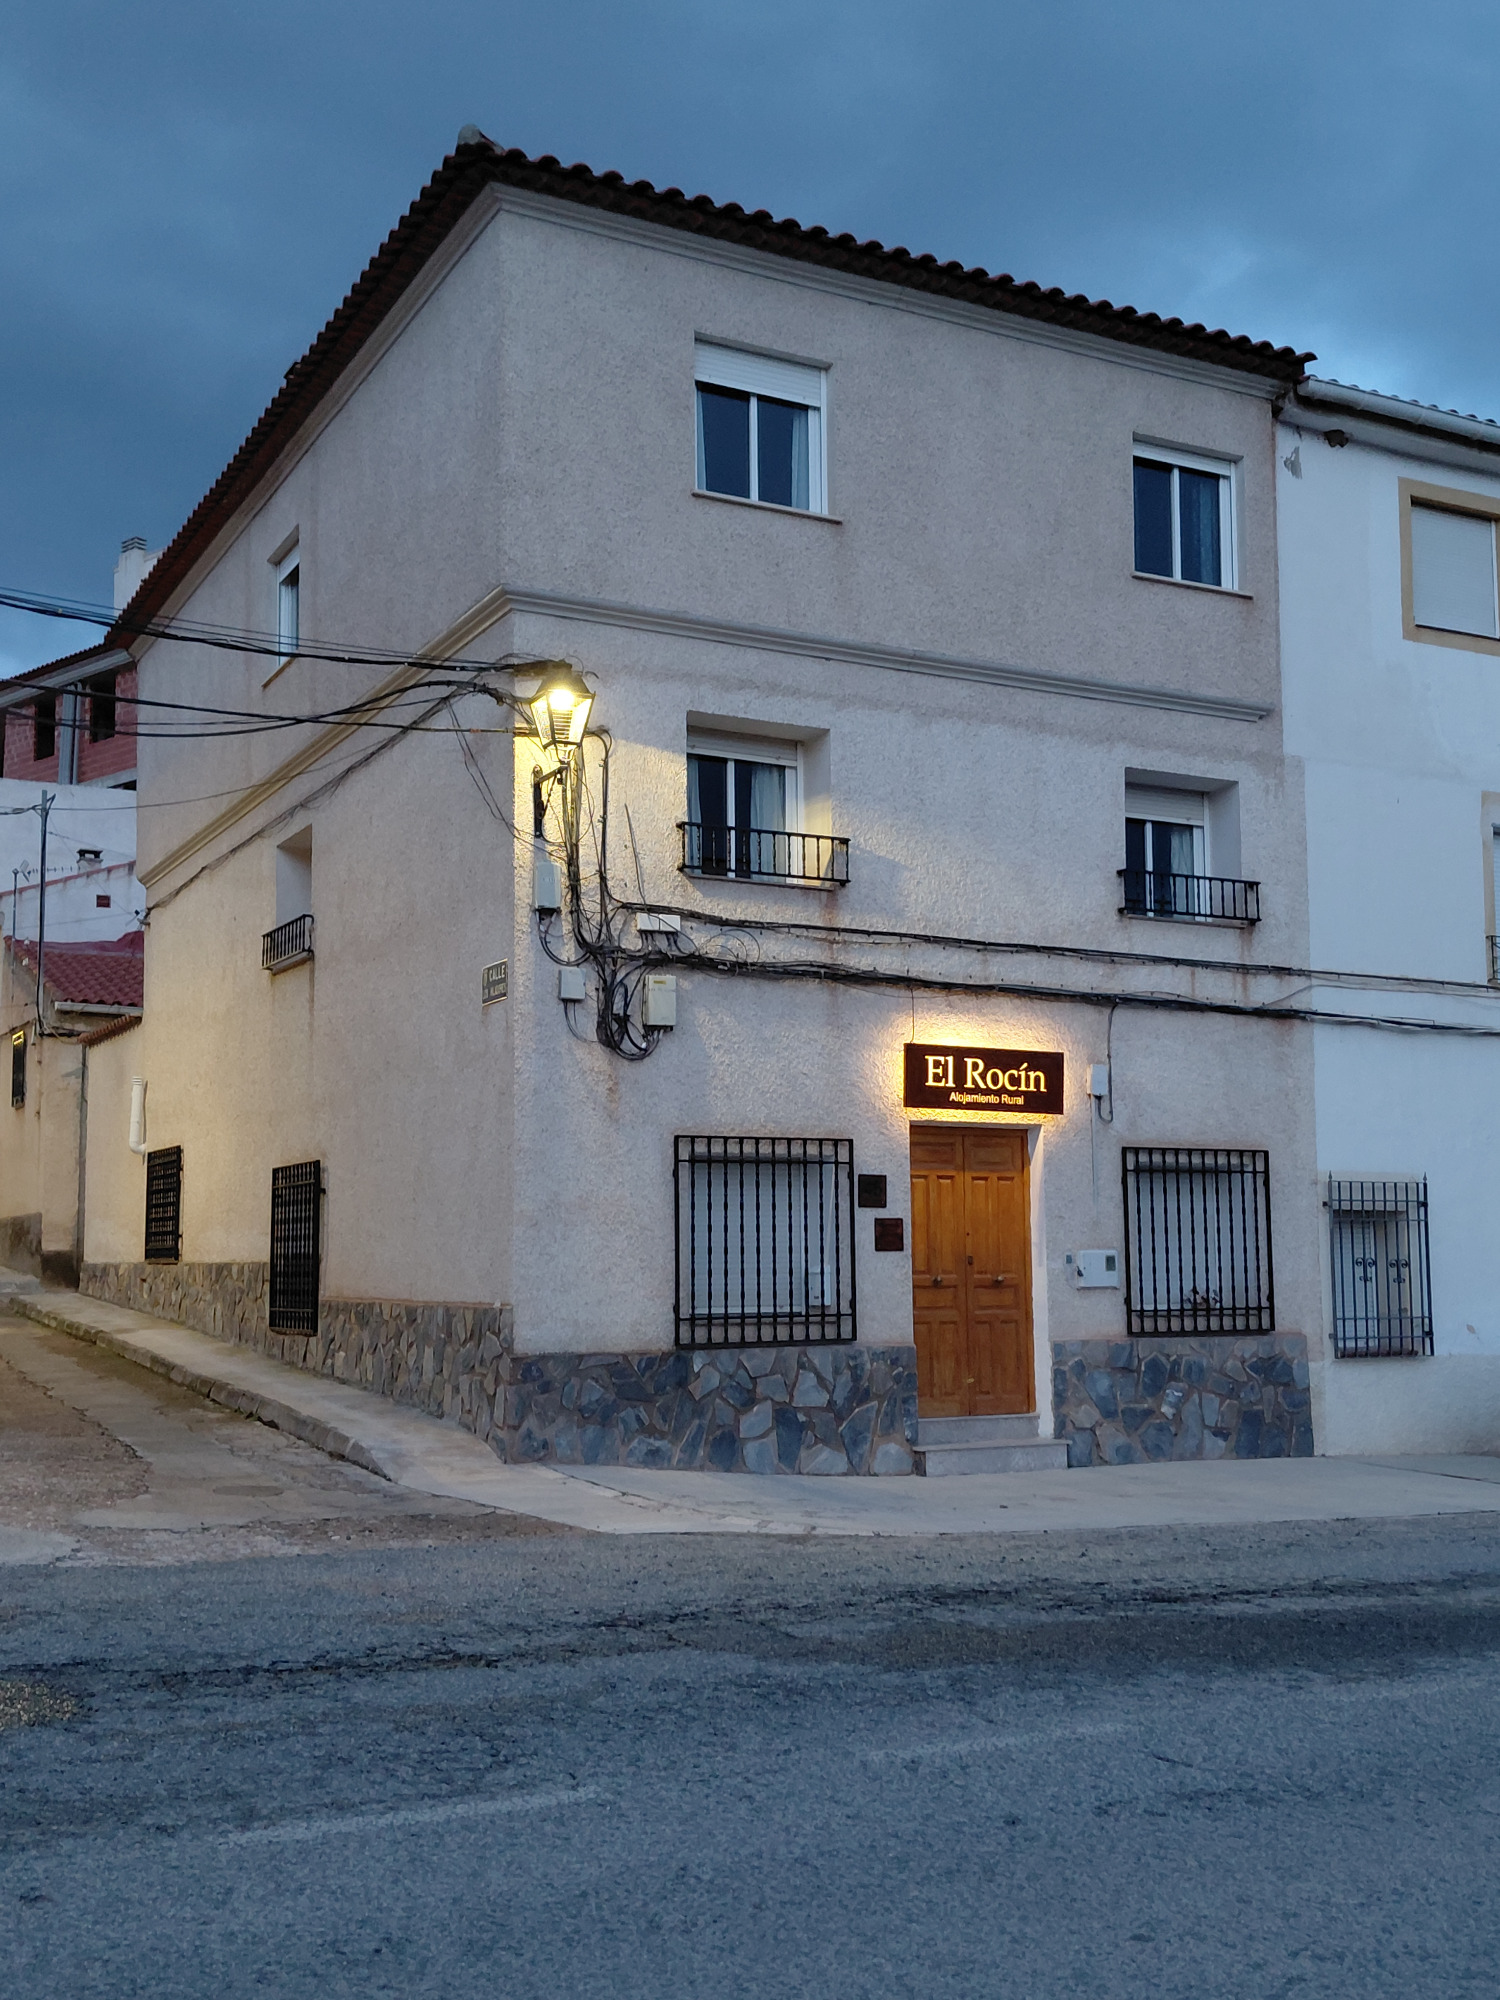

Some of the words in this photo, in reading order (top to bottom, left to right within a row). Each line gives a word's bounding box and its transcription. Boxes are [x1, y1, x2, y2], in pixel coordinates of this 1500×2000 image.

[489, 965, 505, 982] CALLE
[925, 1055, 956, 1087] El
[963, 1058, 1047, 1092] Rocín
[949, 1092, 1000, 1104] Alojamiento
[1001, 1094, 1025, 1105] Rural
